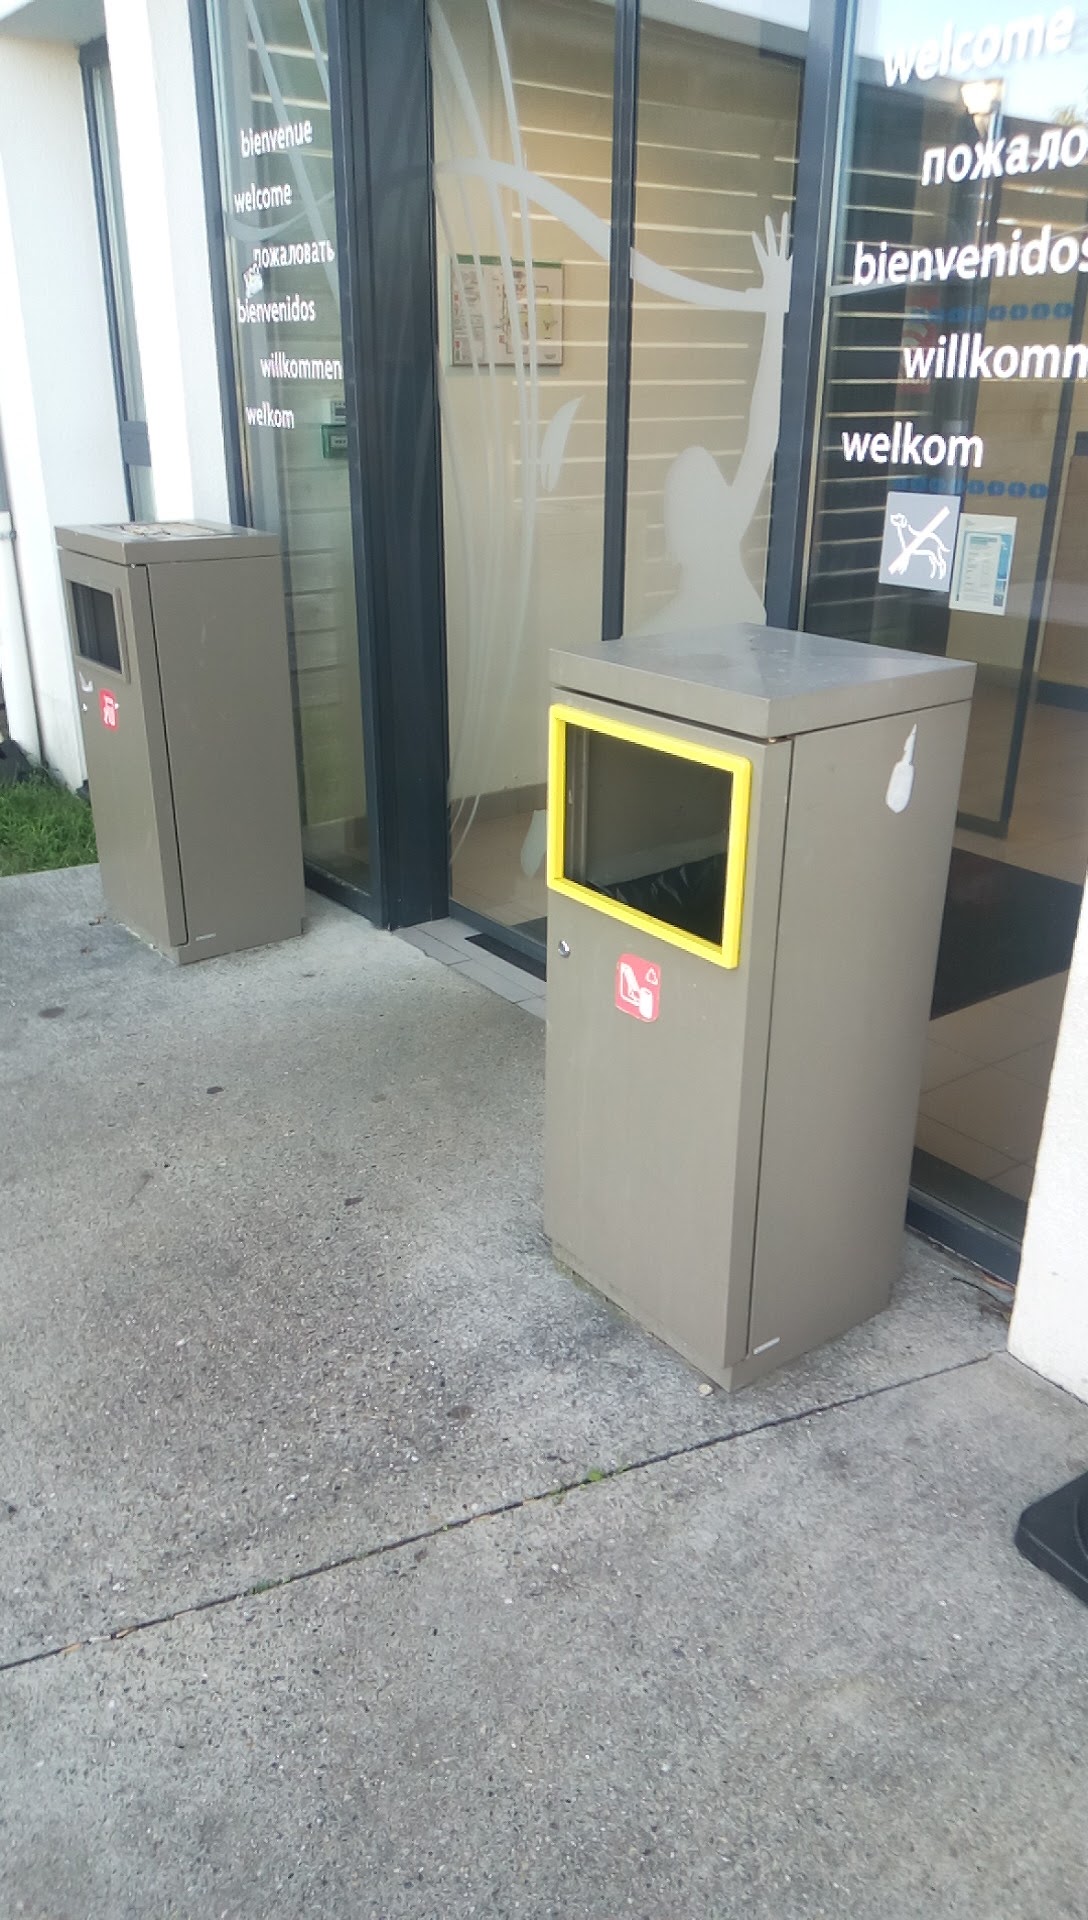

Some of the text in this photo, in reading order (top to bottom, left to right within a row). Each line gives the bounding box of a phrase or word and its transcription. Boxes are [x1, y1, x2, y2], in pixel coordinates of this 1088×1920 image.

[884, 7, 1075, 88] welcome
[241, 120, 313, 158] bienvenue
[921, 127, 1088, 186] пожало
[234, 183, 292, 213] welcome
[253, 240, 335, 268] пожаловать
[236, 293, 316, 323] bienvenidos
[260, 352, 343, 380] willkommen
[246, 402, 294, 429] welkom
[842, 421, 984, 467] welkom
